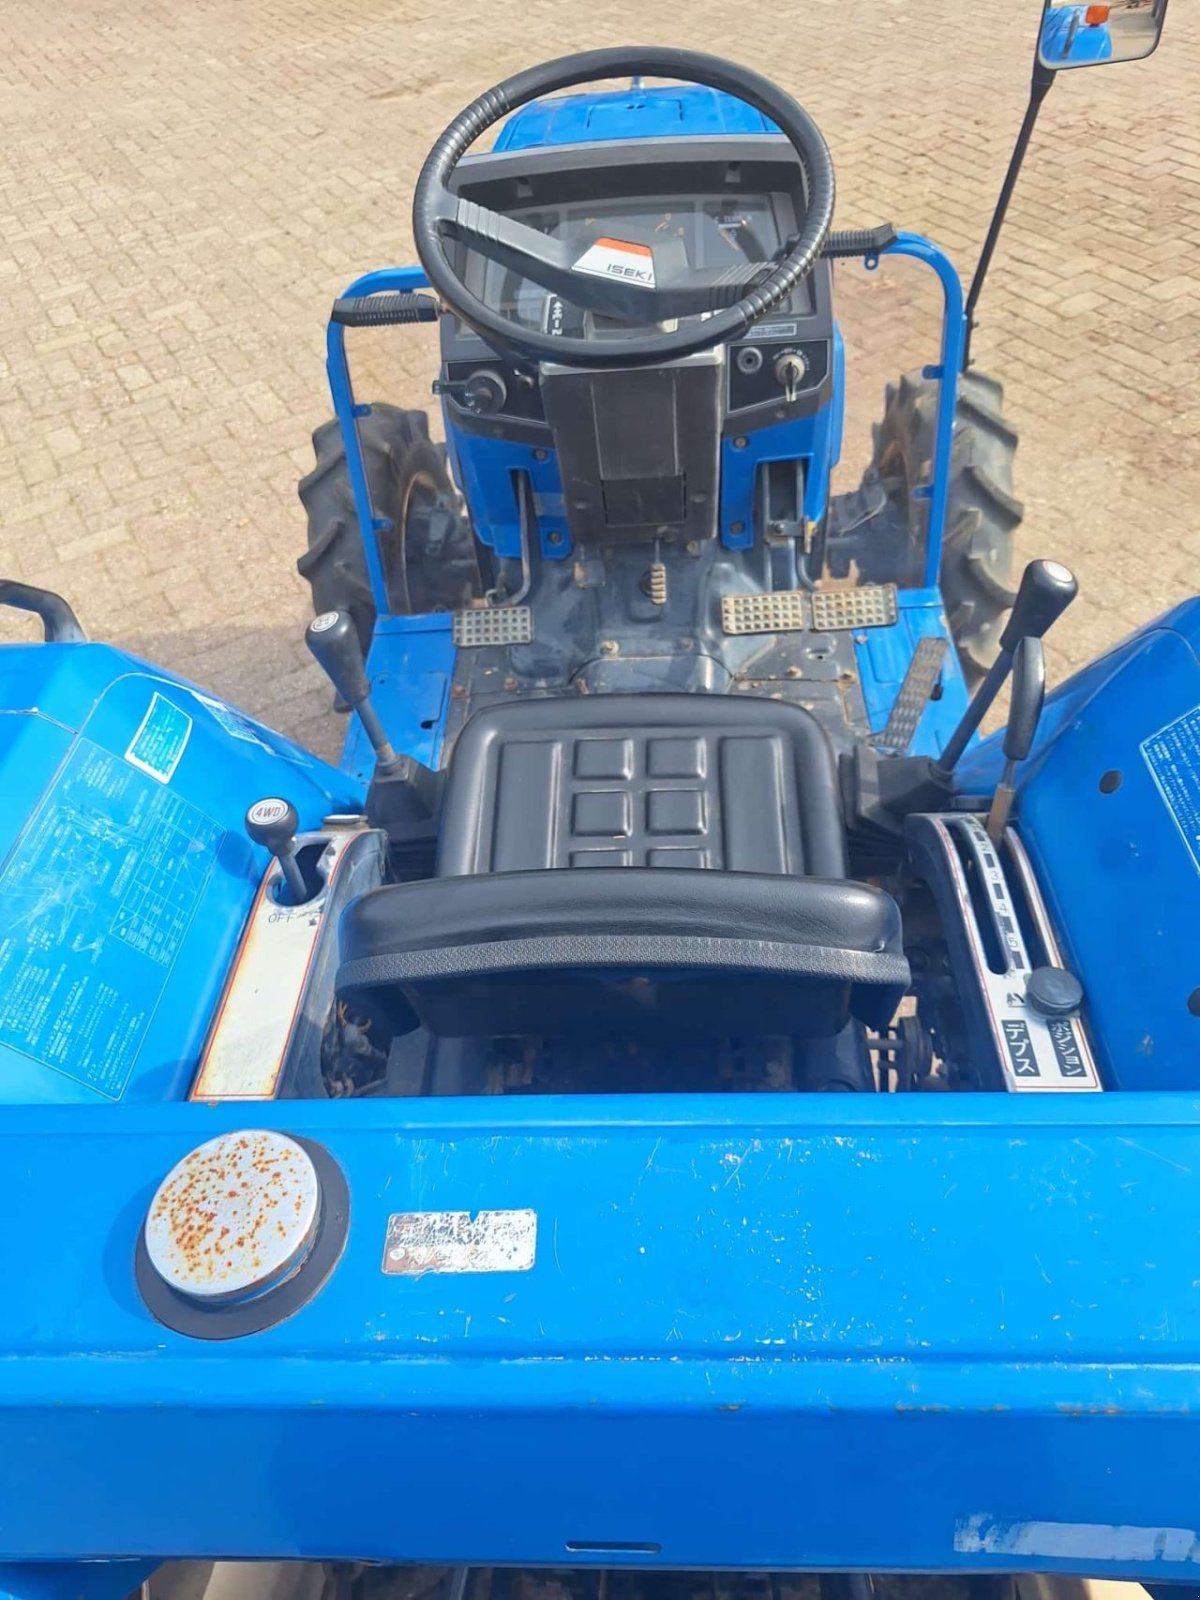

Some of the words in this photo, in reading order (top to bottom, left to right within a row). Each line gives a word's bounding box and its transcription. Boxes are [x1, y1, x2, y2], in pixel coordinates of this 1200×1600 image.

[607, 263, 653, 281] ISEKI
[255, 806, 281, 818] 4WD
[991, 870, 999, 881] 3
[999, 902, 1008, 912] 4
[1051, 1020, 1082, 1077] ポジション
